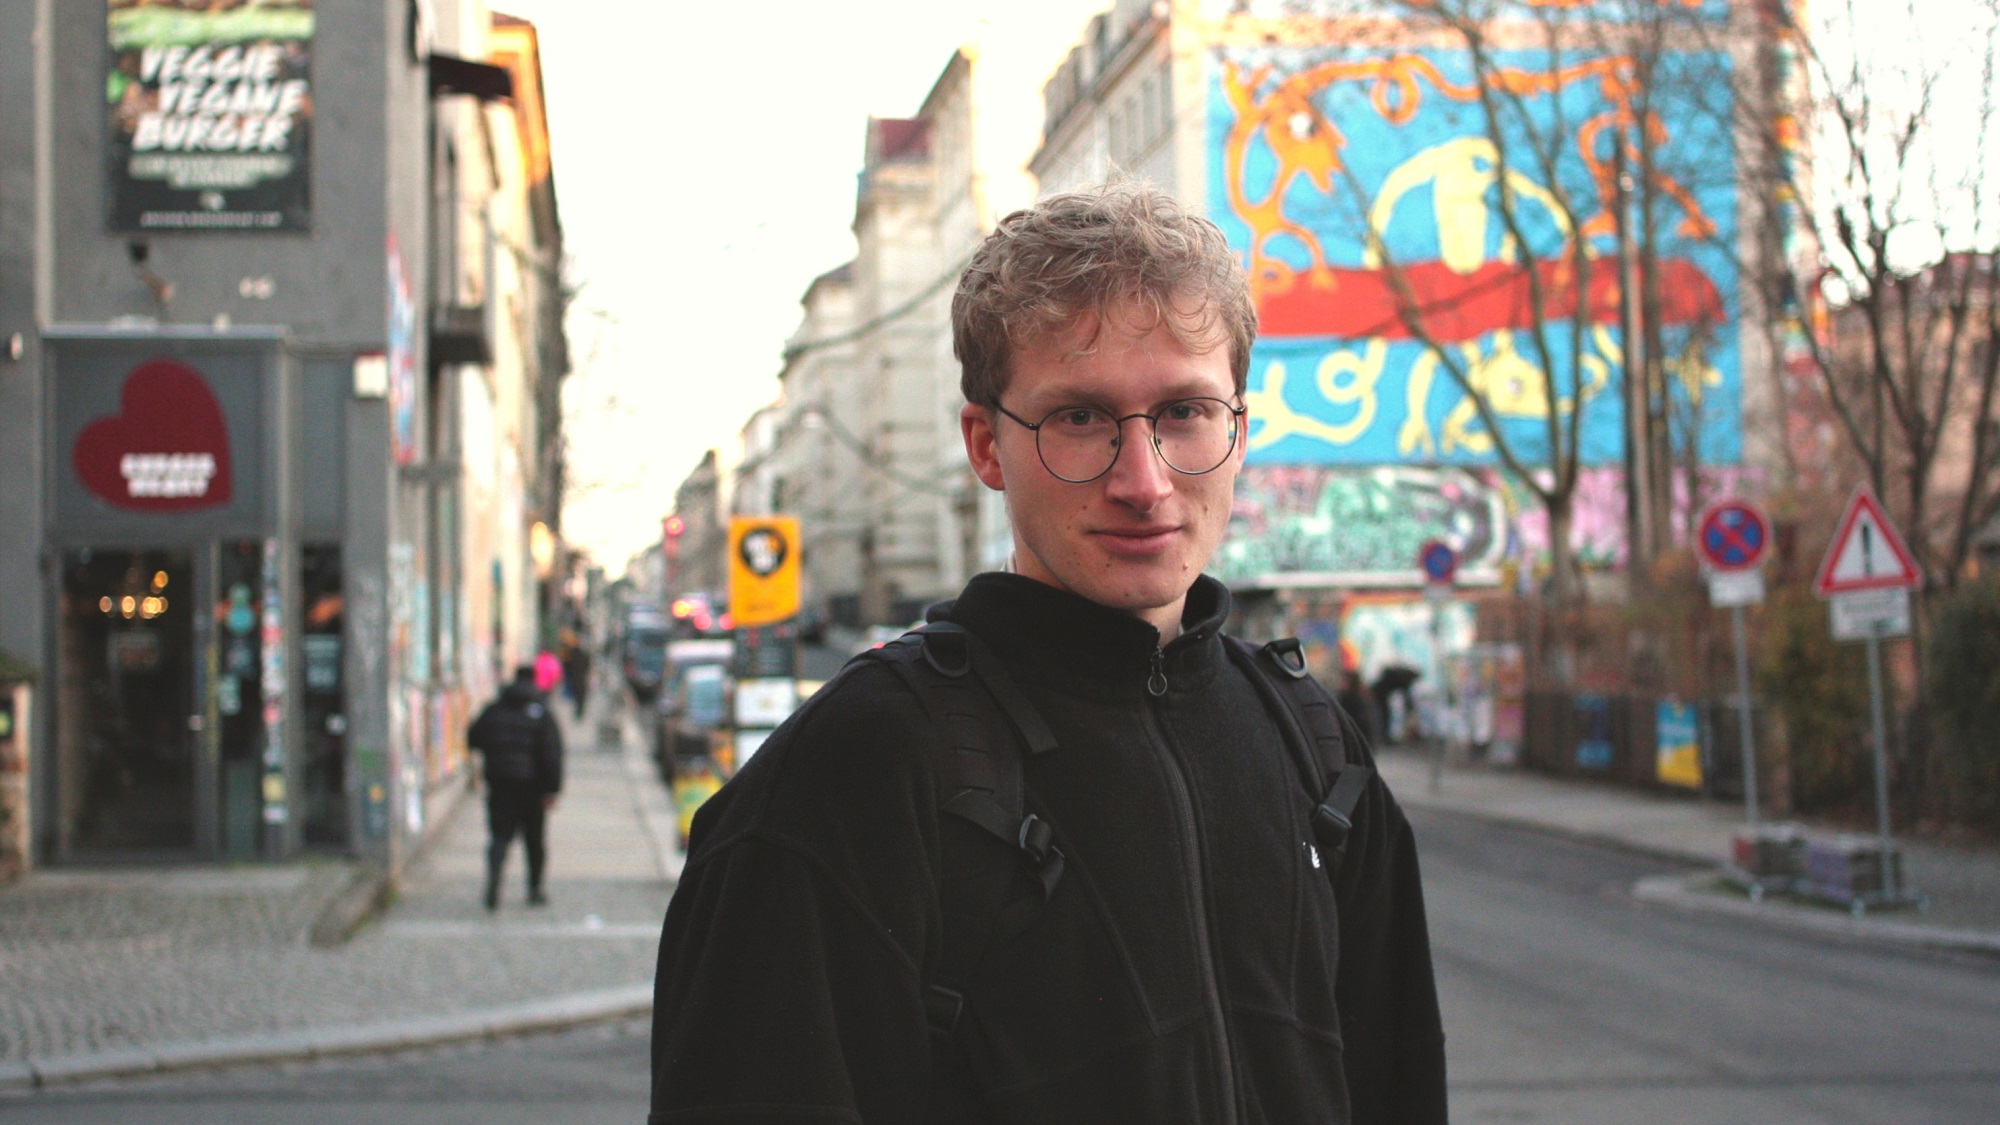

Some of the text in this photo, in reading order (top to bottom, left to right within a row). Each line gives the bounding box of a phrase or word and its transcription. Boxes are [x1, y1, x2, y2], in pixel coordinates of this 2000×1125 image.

[140, 45, 284, 83] VEGGIE
[158, 80, 307, 116] VEGANE
[132, 111, 293, 151] BURGER
